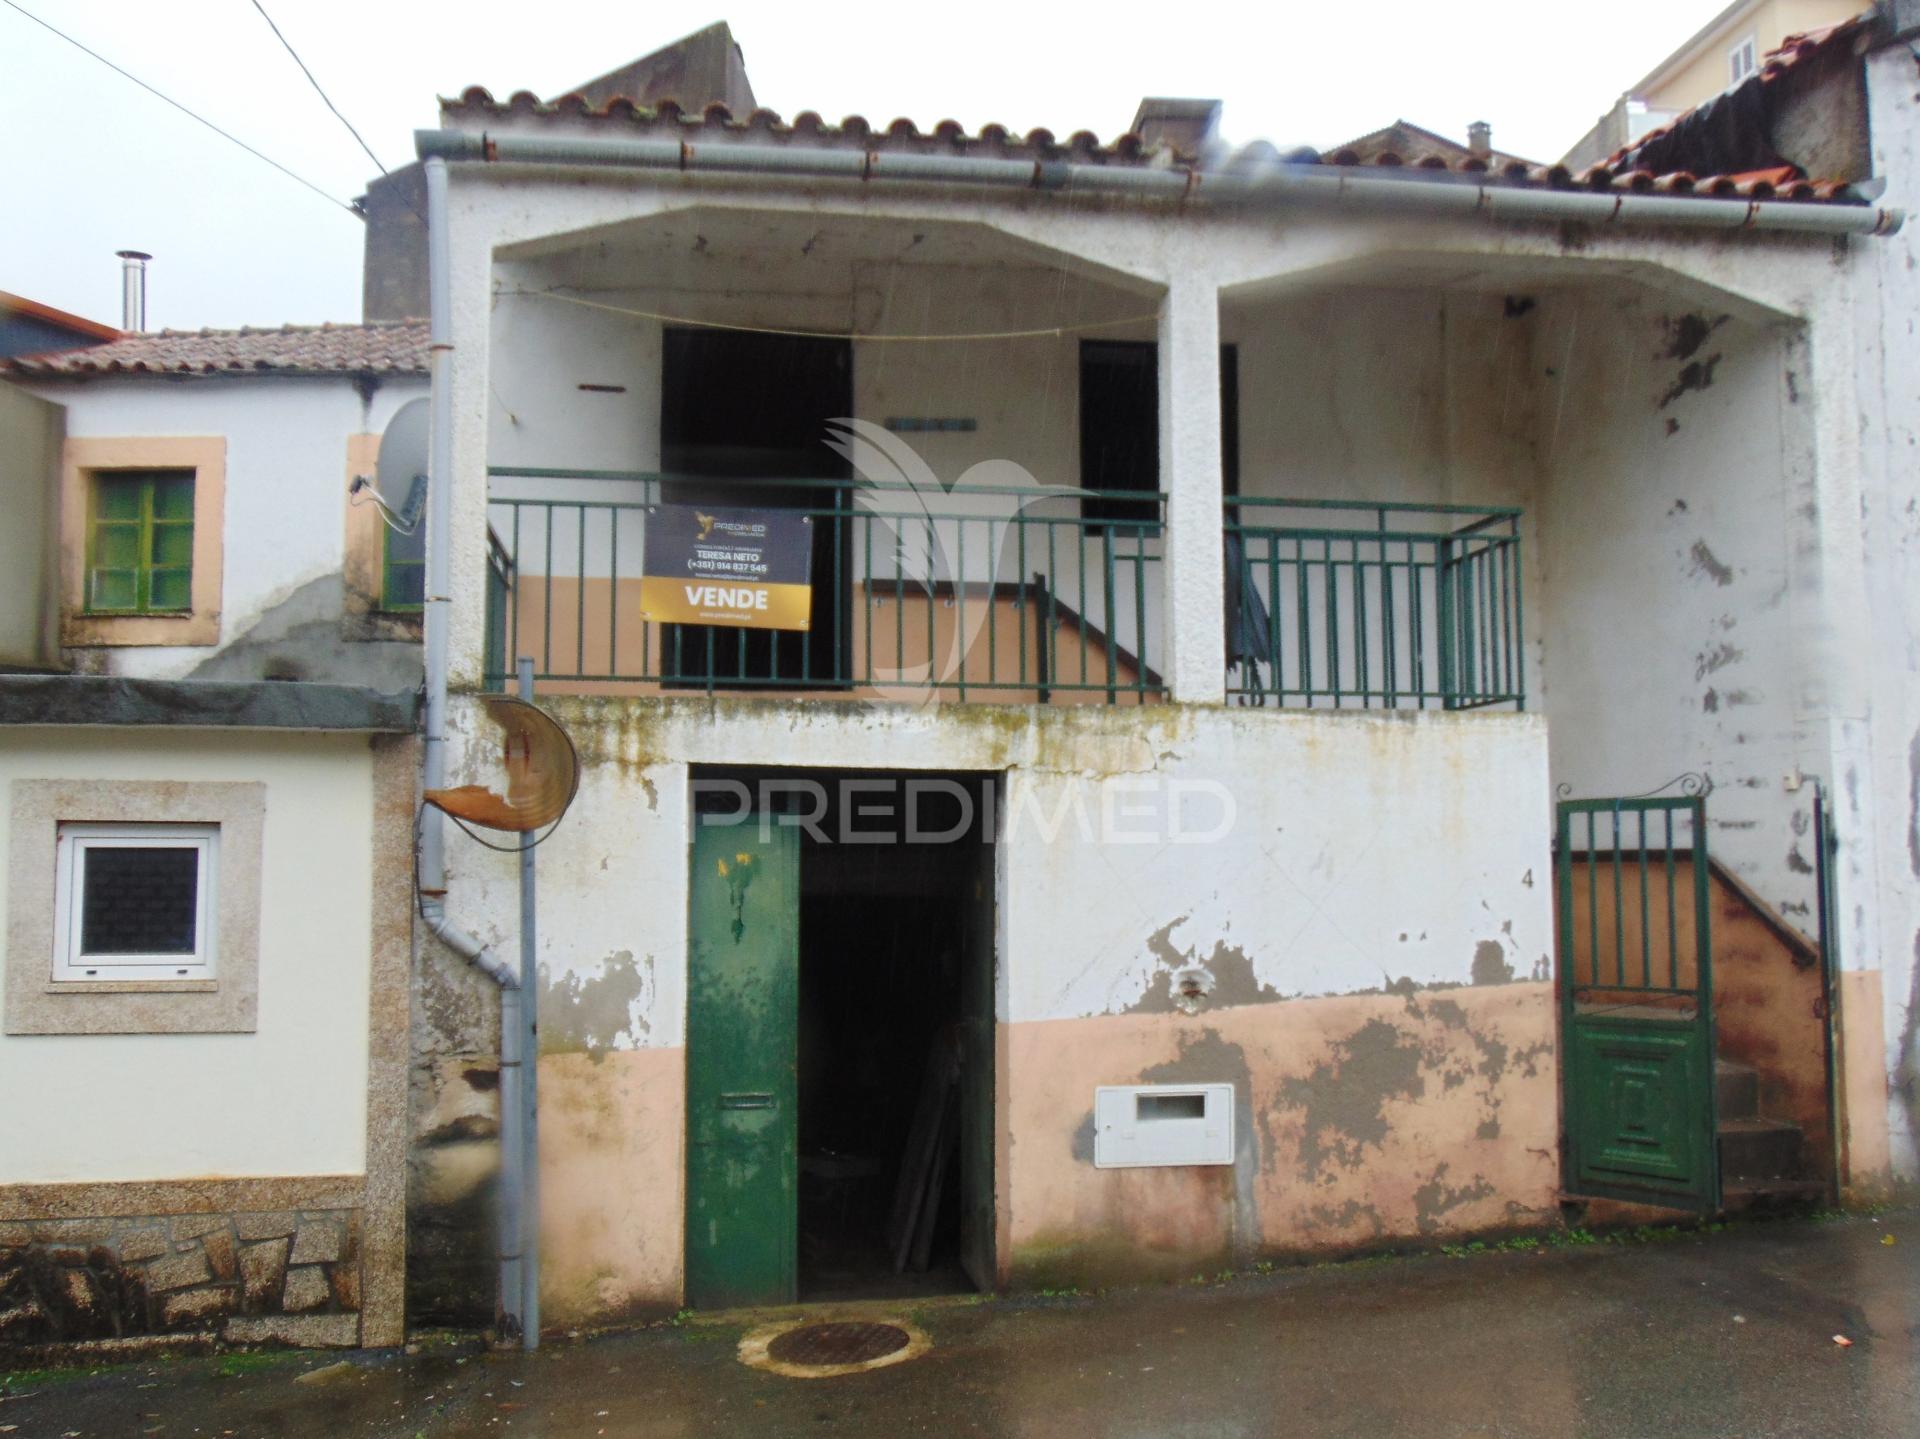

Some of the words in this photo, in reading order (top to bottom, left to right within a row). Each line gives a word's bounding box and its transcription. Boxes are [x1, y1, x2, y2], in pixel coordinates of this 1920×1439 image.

[697, 550, 732, 561] TERESA
[733, 552, 759, 562] NETO
[685, 585, 769, 610] VENDE
[1521, 868, 1535, 889] 4
